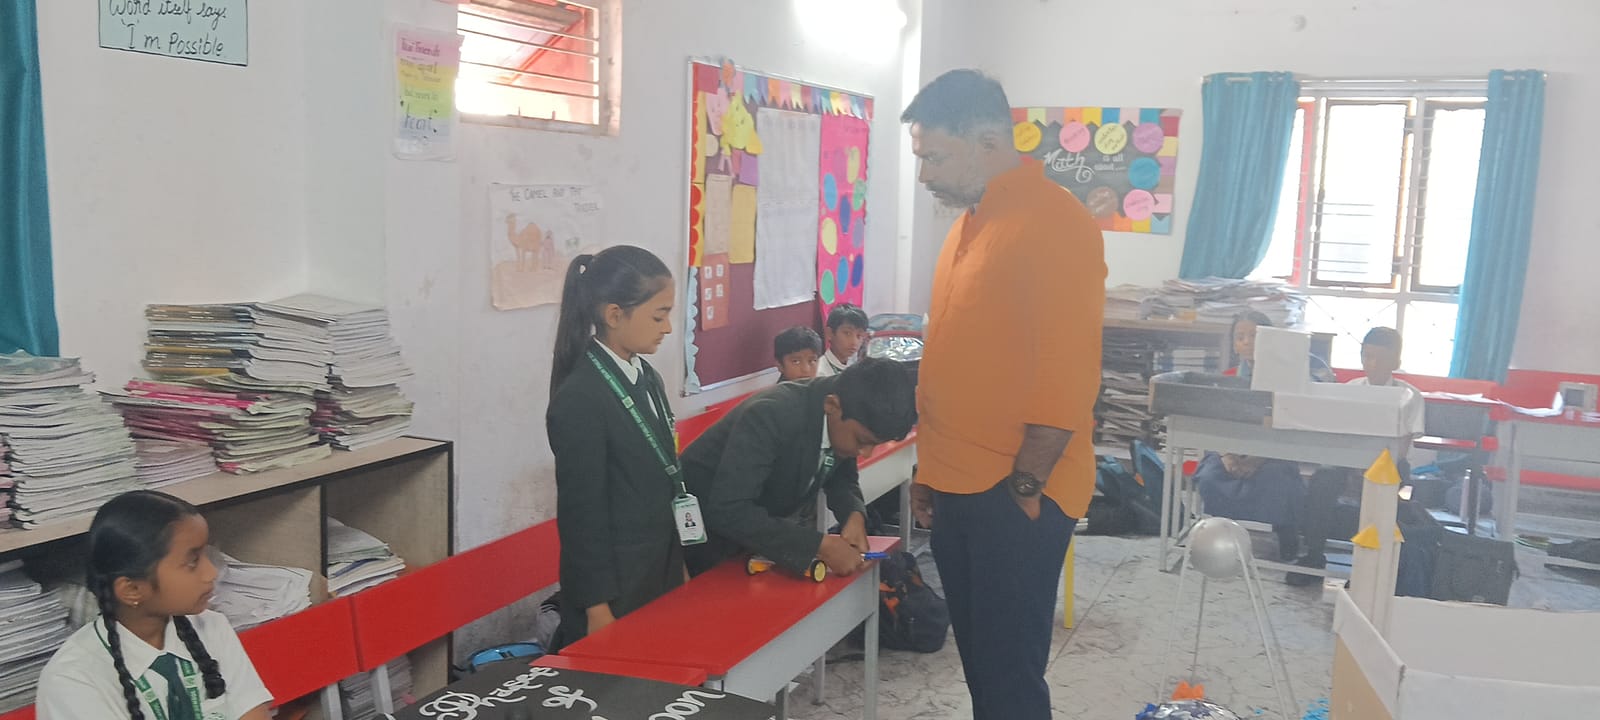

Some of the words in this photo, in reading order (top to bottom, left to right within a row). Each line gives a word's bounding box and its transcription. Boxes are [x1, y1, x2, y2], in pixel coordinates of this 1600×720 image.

[169, 32, 224, 56] Possible
[1043, 148, 1095, 183] Math
[542, 685, 598, 712] of
